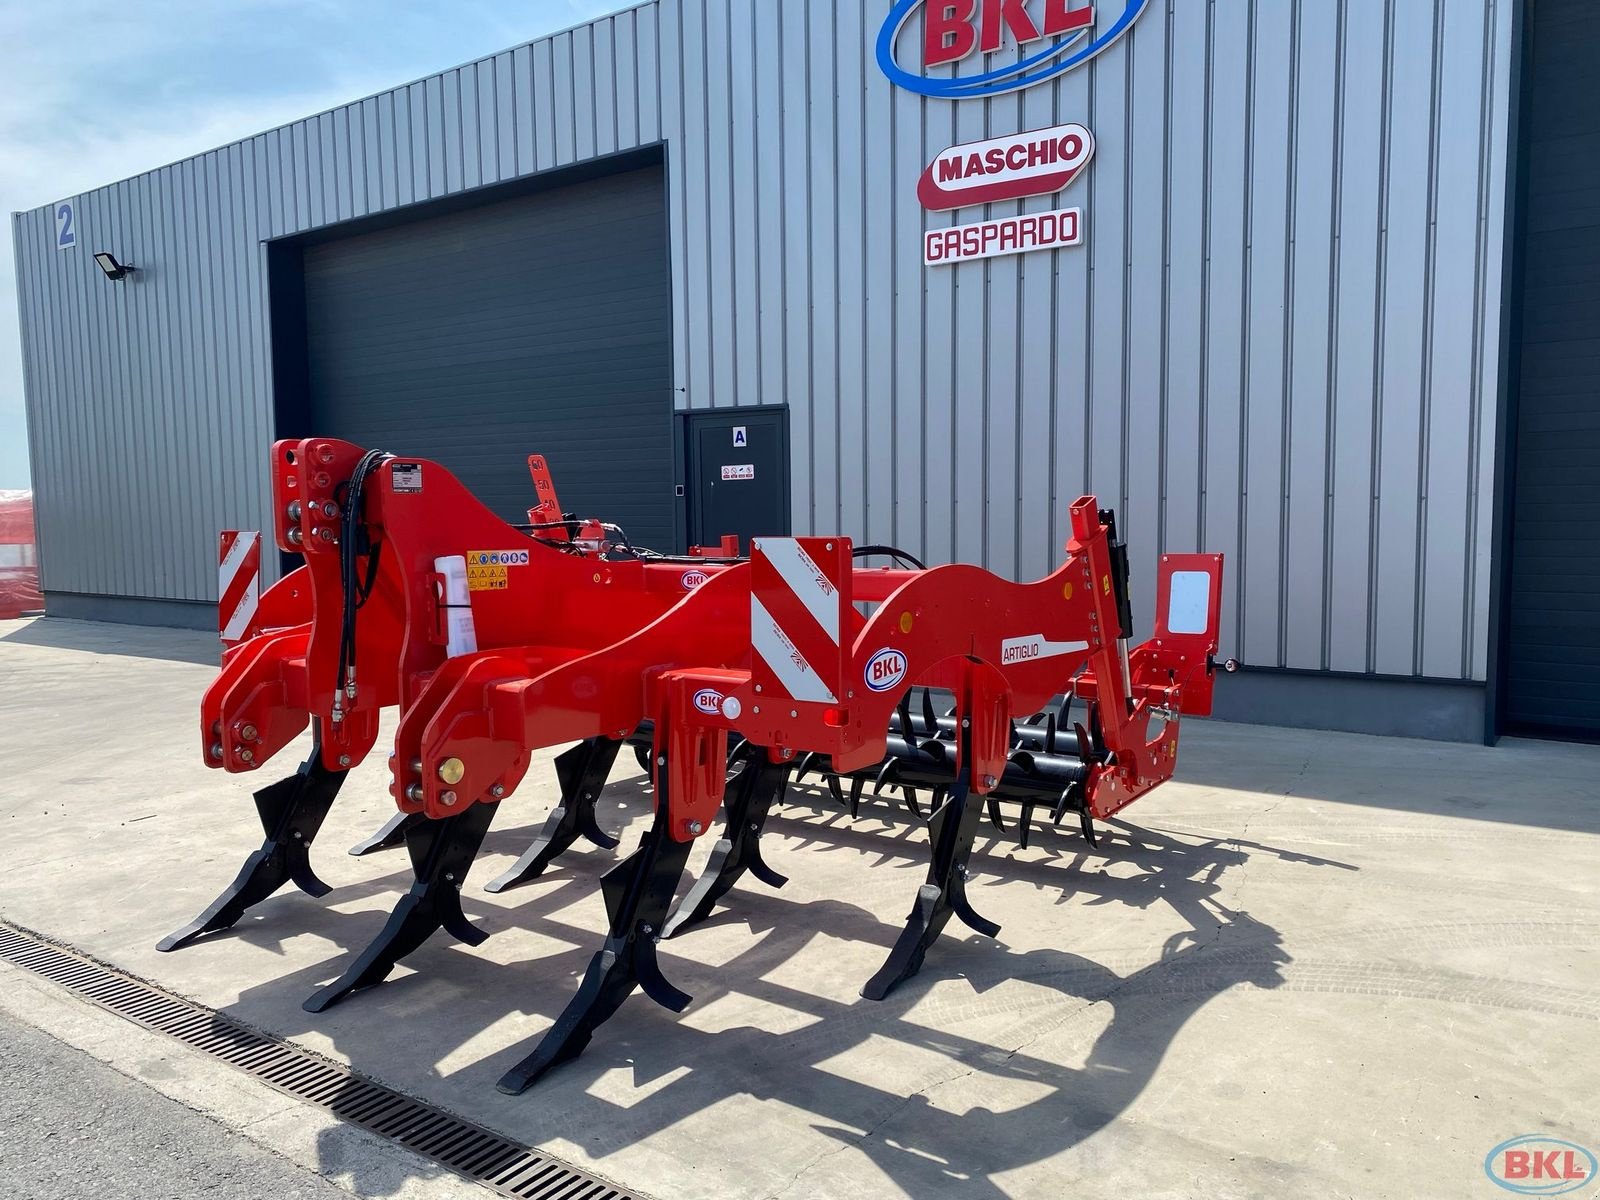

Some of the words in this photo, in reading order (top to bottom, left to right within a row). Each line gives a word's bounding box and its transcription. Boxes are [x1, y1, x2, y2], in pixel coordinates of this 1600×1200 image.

[925, 0, 1094, 66] BKL
[938, 133, 1083, 183] MASCHIO
[58, 204, 75, 245] 2
[926, 211, 1078, 262] GASPARDO
[735, 430, 745, 443] A
[532, 459, 544, 470] 60
[538, 479, 550, 490] 50
[1003, 643, 1039, 662] ARTIGLIO
[873, 655, 902, 681] BKL
